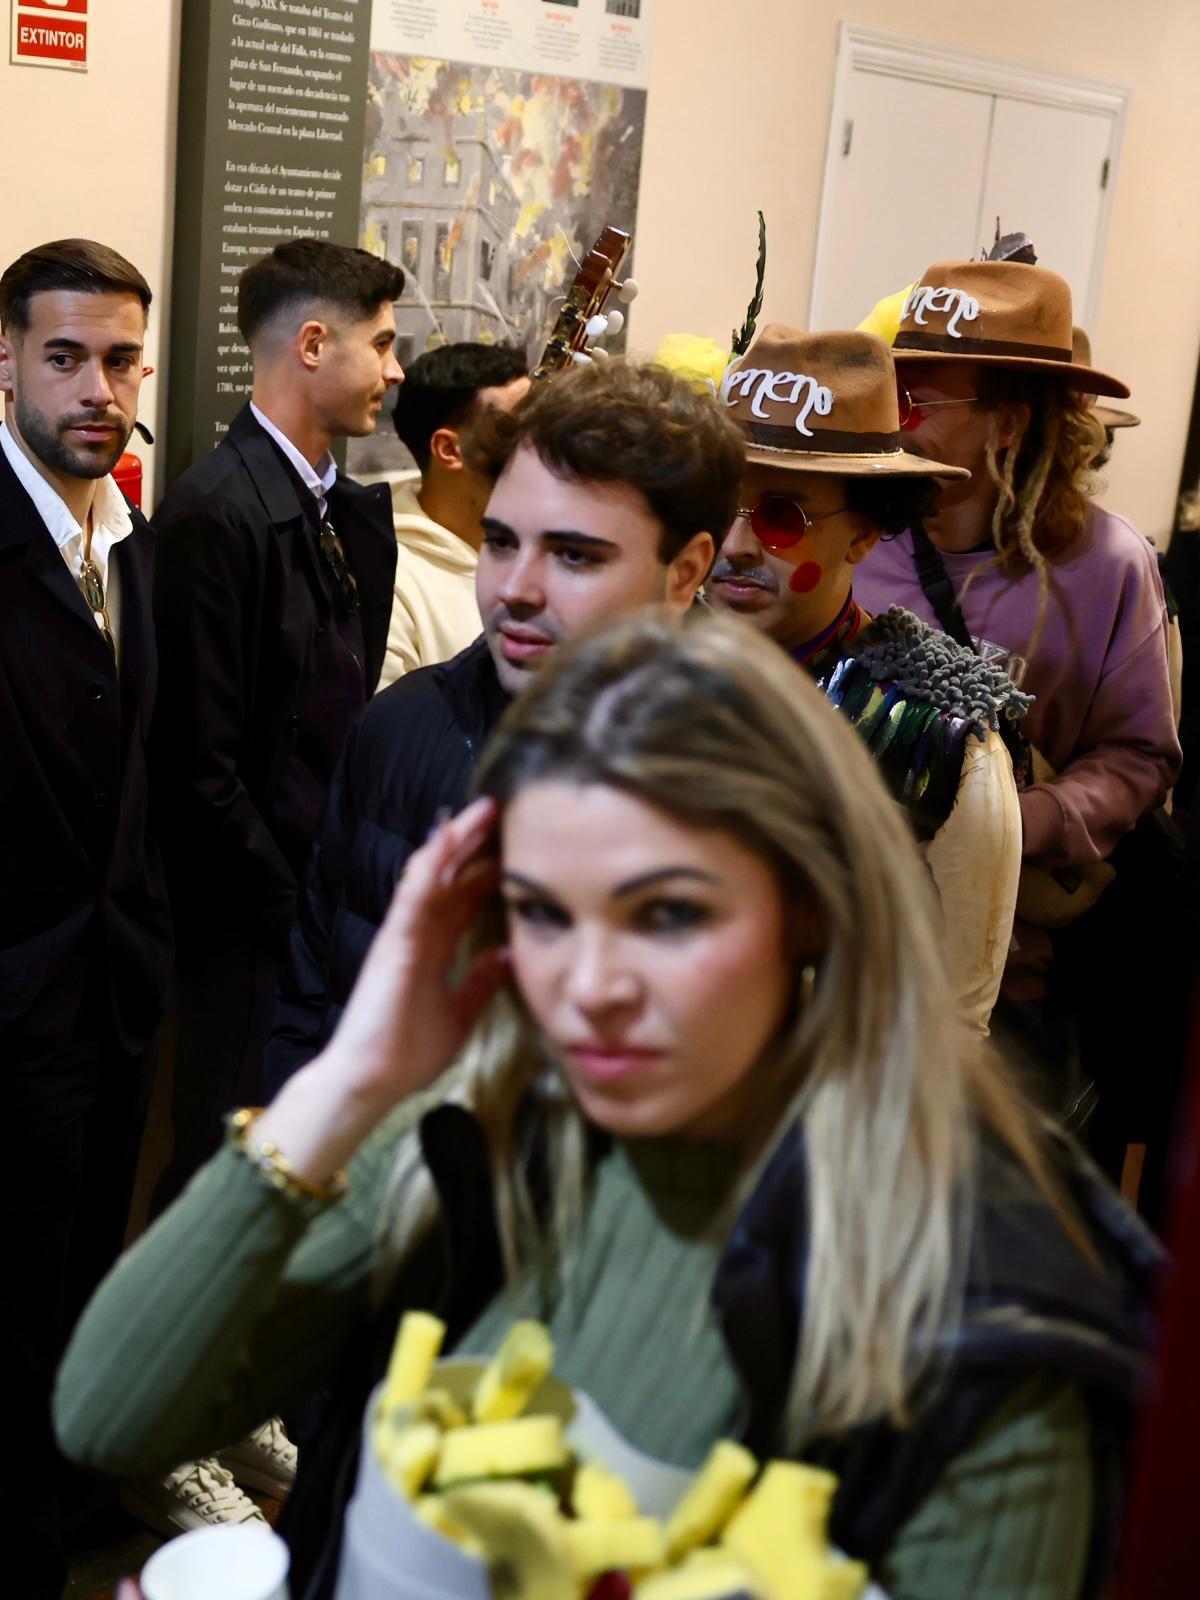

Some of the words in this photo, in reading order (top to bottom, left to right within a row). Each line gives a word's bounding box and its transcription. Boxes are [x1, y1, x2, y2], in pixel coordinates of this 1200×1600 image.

[280, 1, 288, 11] Se
[312, 6, 321, 17] del
[343, 11, 353, 23] del
[232, 14, 251, 26] Circo
[285, 25, 297, 36] que
[20, 27, 84, 49] EXTINTOR
[237, 36, 244, 47] la
[245, 39, 265, 50] actual
[266, 41, 279, 52] sede
[280, 42, 290, 53] del
[292, 44, 308, 57] Falla,
[318, 48, 324, 59] la
[230, 57, 248, 70] plaza
[249, 59, 258, 70] de
[259, 60, 271, 72] San
[272, 62, 304, 77] Fernando,
[335, 71, 342, 82] el
[230, 77, 247, 91] lugar
[248, 80, 257, 91] de
[267, 84, 295, 95] mercado
[304, 87, 338, 100] decadencia
[228, 97, 235, 109] la
[236, 101, 264, 113] apertura
[264, 102, 275, 113] del
[228, 119, 257, 132] Mercado
[258, 122, 282, 135] Central
[292, 125, 298, 137] la
[299, 127, 315, 140] plaza
[317, 128, 343, 141] Libertad.
[226, 160, 235, 172] En
[237, 164, 247, 172] esa
[248, 162, 271, 174] década
[272, 165, 278, 175] el
[279, 165, 322, 178] Ayuntamiento
[224, 181, 242, 193] dotar
[249, 183, 268, 195] Cádiz
[269, 185, 277, 195] de
[288, 188, 306, 197] teatro
[306, 187, 314, 198] de
[315, 189, 336, 201] primer
[224, 202, 243, 213] orden
[253, 205, 292, 216] consonancia
[293, 208, 304, 217] con
[305, 207, 313, 217] los
[314, 209, 326, 220] que
[223, 222, 248, 234] estaban
[248, 223, 283, 235] levantando
[293, 226, 315, 239] España
[223, 242, 248, 256] Europa,
[218, 345, 230, 356] que
[217, 365, 228, 373] vez
[229, 365, 241, 375] que
[242, 362, 249, 372] el
[215, 421, 229, 432] Tras
